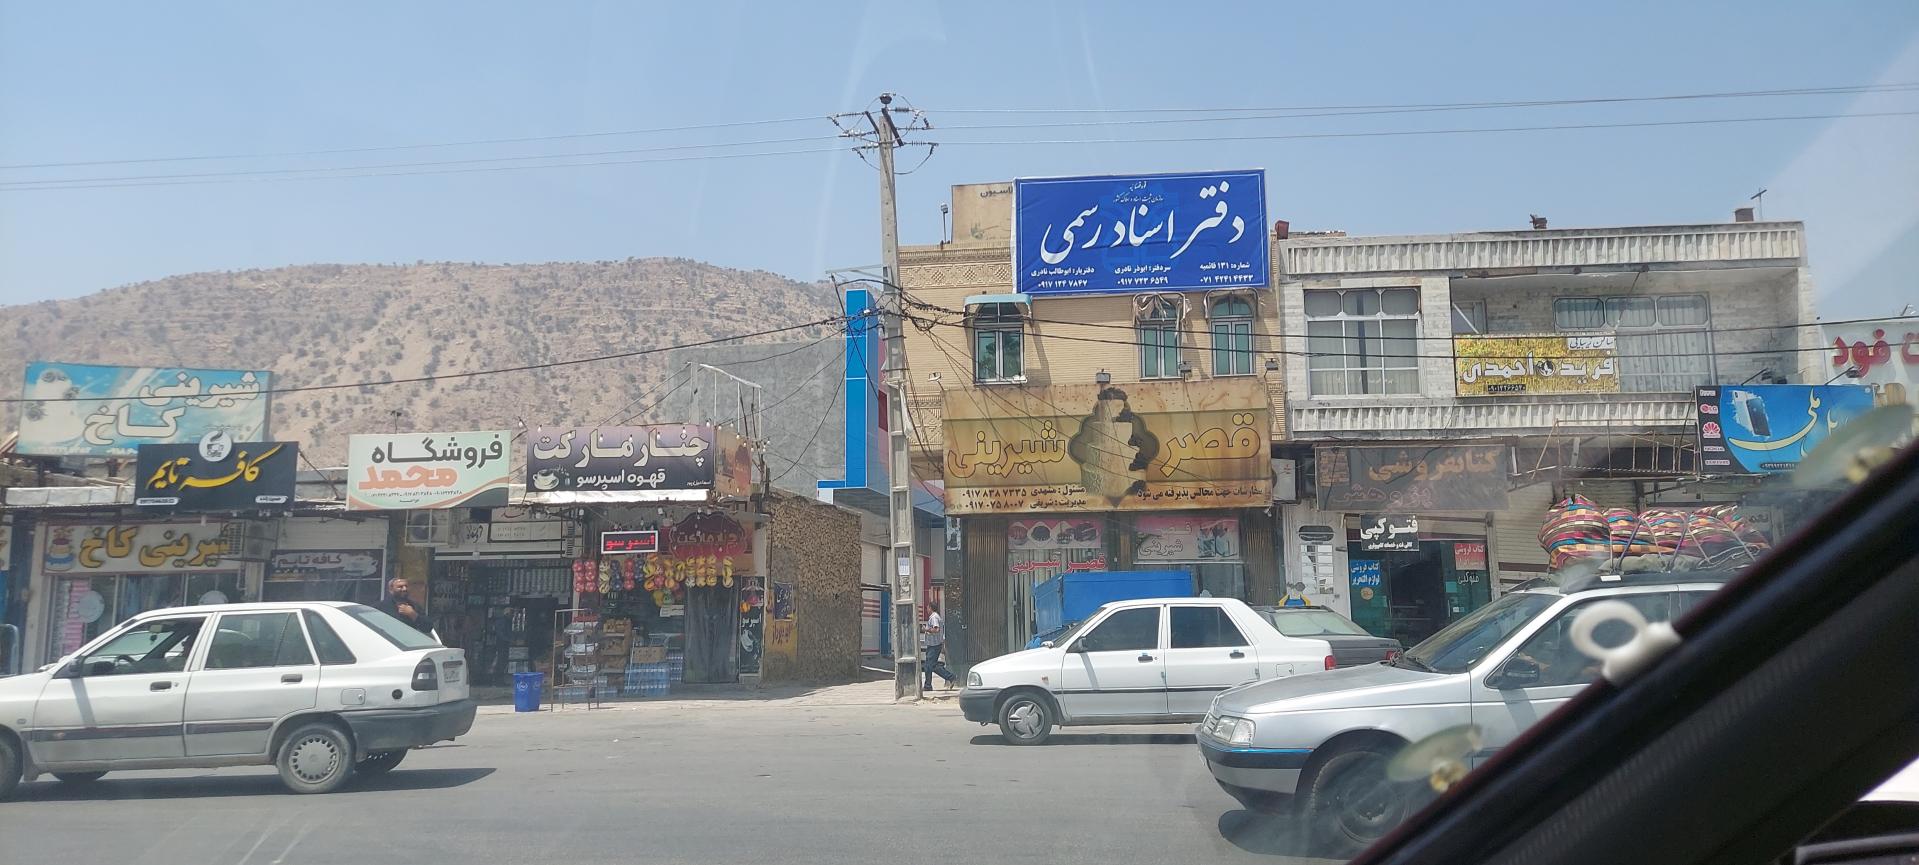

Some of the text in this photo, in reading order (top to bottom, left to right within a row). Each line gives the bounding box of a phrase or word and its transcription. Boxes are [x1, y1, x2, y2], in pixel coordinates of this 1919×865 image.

[1040, 180, 1245, 264] دفتر اسناد رسمی
[1217, 261, 1229, 269] ۱۳۱
[1038, 280, 1053, 288] ۰۹۱۷
[1117, 277, 1133, 286] ۰۹۱۷
[1833, 329, 1891, 378] فود
[1462, 350, 1614, 385] فرید احمدی
[138, 371, 261, 408] شیرینی
[83, 404, 187, 445] کاخ
[371, 433, 503, 469] فروشگاه
[533, 427, 710, 468] چنار مارکت
[947, 412, 1261, 478] قصر شیرینی
[146, 457, 190, 489] تایم
[358, 465, 458, 490] محمد
[576, 468, 666, 490] قهوه اسپرسو
[962, 489, 981, 498] ۰۹۱۷
[983, 488, 1001, 498] ۸۳۸
[1137, 488, 1152, 500] شود
[1152, 490, 1163, 500] می
[1164, 486, 1189, 500] پذیرفته
[1190, 486, 1214, 499] مجالس
[965, 500, 984, 510] ۰۹۱۷
[986, 500, 1002, 509] ۰۷۵
[78, 526, 140, 568] کاخ
[1140, 538, 1184, 557] شیرینی
[278, 553, 342, 567] کافه تایم
